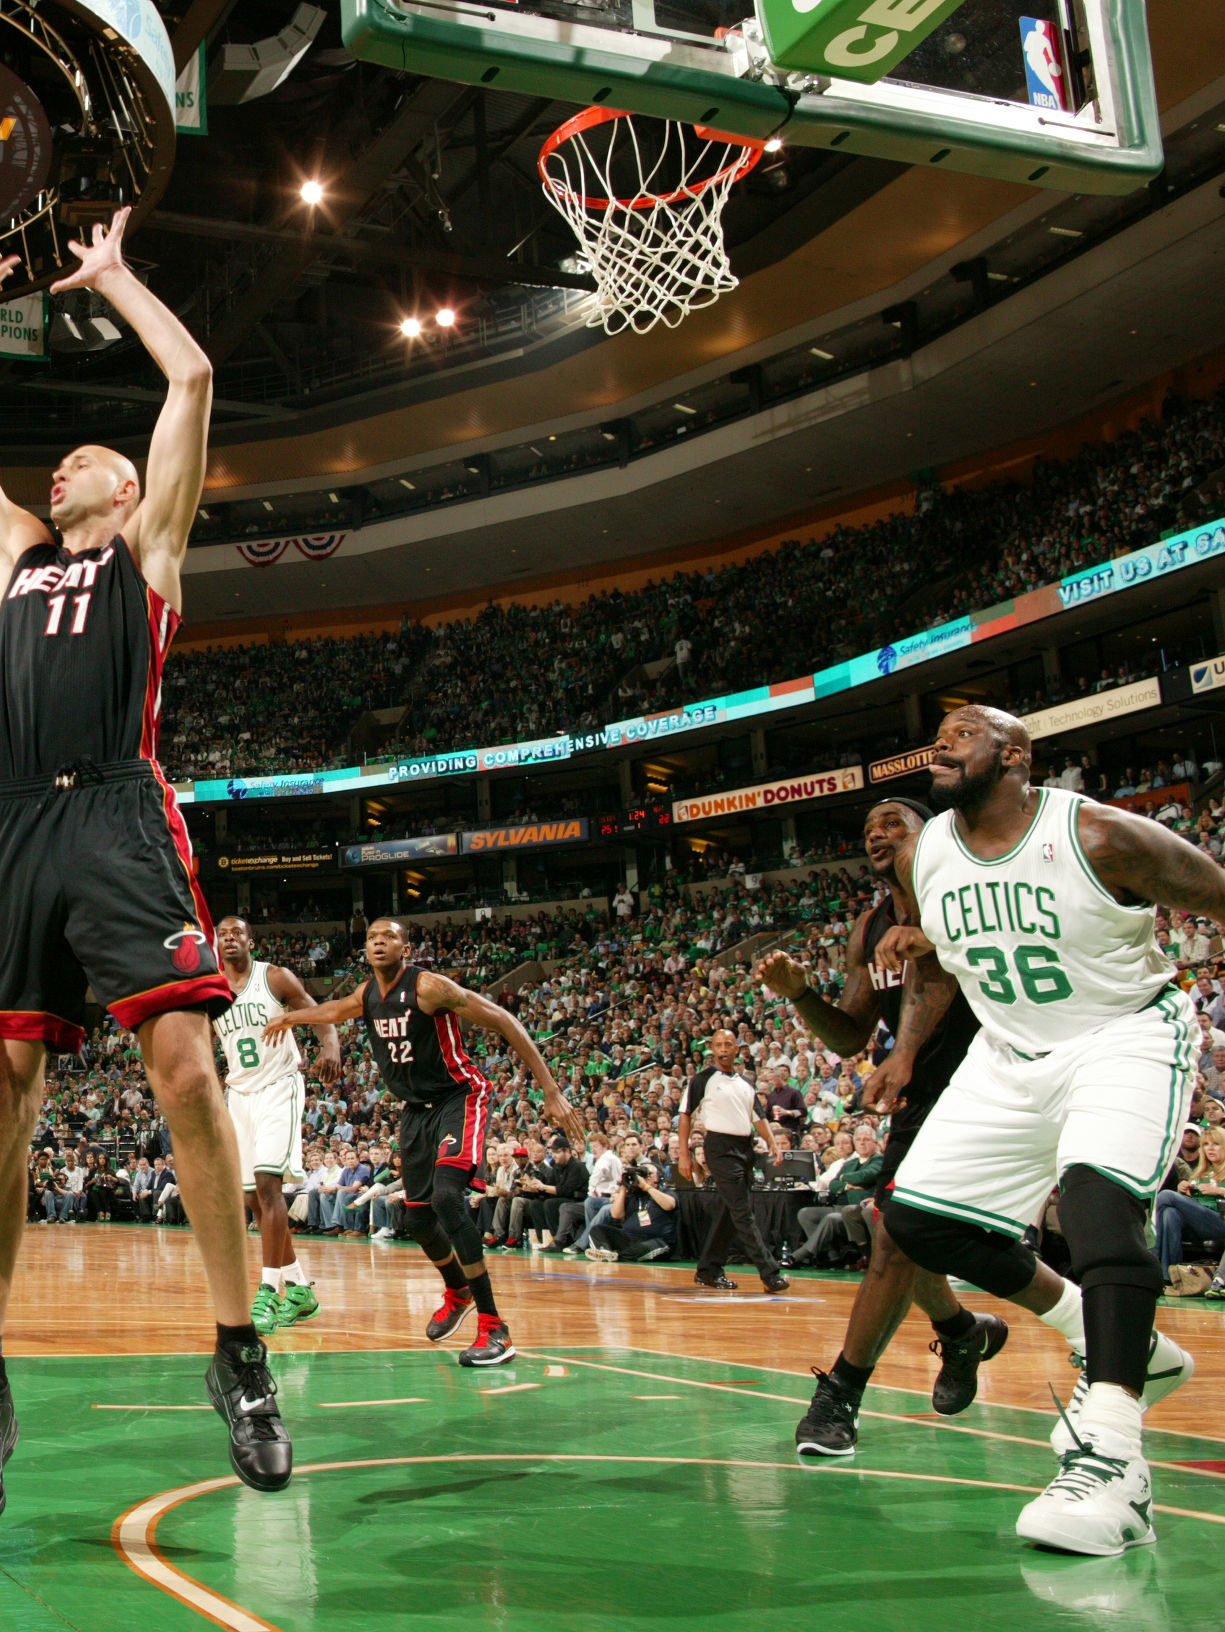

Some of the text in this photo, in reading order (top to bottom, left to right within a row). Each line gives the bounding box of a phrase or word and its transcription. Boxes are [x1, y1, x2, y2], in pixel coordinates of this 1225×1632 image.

[1033, 92, 1056, 109] NBA
[7, 546, 115, 599] HEAT
[1057, 568, 1113, 604] VISIT
[1120, 555, 1152, 582] US
[1157, 540, 1188, 569] AT
[44, 591, 92, 636] 11
[899, 638, 927, 658] Safety
[930, 621, 979, 644] Insurance
[1048, 702, 1105, 729] Technology
[1106, 687, 1158, 712] Solutions
[387, 705, 717, 781] PROVIDING COMPREHENSIVE COVERAGE
[689, 776, 838, 819] DUNKIN' DONUTS
[470, 821, 581, 851] SYLVANIA
[941, 881, 1062, 943] CELTICS
[965, 945, 1075, 1006] 36
[216, 1002, 269, 1037] CELTICS
[373, 1007, 412, 1038] HEAT
[237, 1037, 260, 1069] 8
[387, 1040, 414, 1064] 22
